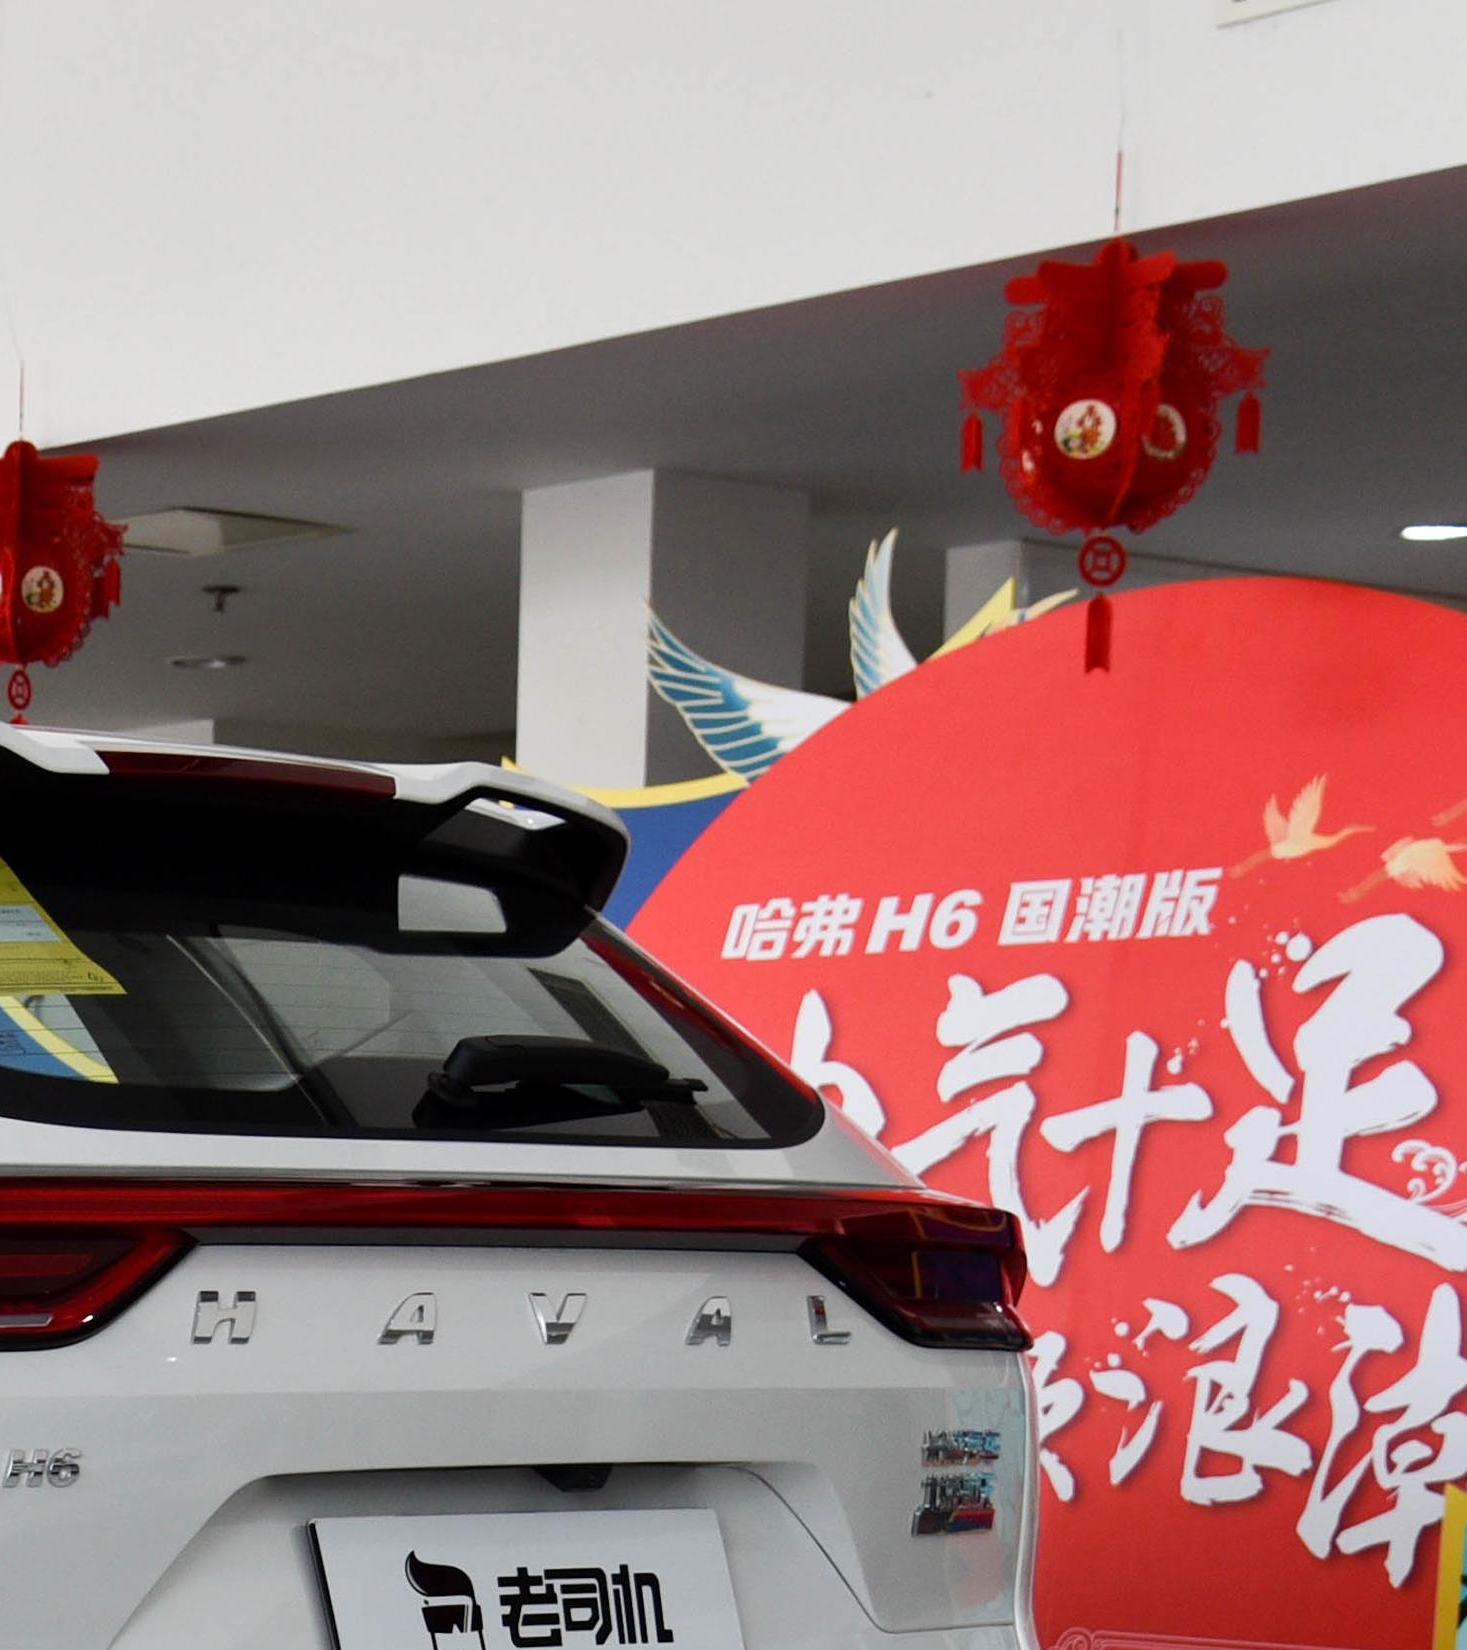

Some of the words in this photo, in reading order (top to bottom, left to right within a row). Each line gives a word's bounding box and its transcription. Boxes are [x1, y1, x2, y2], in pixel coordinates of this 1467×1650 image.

[191, 1289, 852, 1347] HAVAL
[498, 1563, 674, 1649] 老司机
